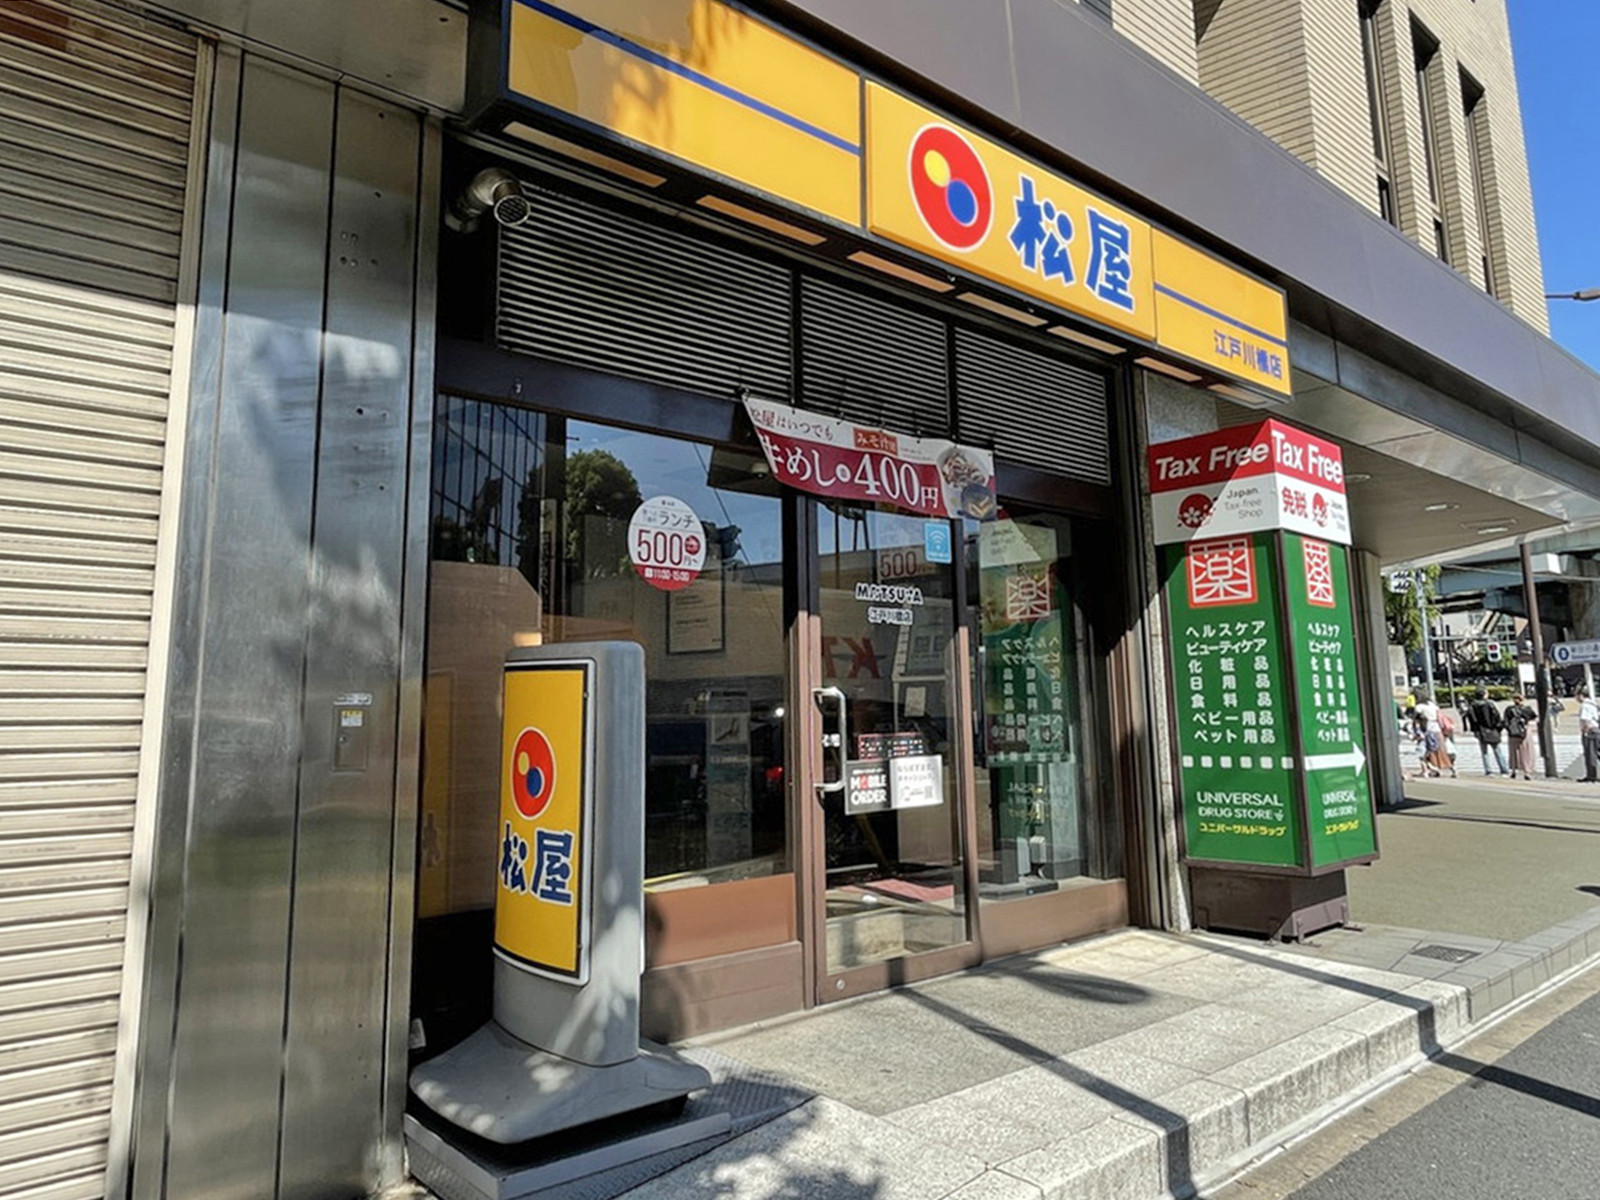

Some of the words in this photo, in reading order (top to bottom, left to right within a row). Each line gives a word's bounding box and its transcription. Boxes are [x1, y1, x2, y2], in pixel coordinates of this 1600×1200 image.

[1007, 173, 1136, 314] 松屋
[1156, 456, 1202, 480] Tax
[1209, 442, 1270, 472] Free
[1271, 430, 1303, 472] Tax
[1308, 444, 1343, 484] Free
[1226, 487, 1259, 499] Japan
[1281, 486, 1308, 519] 免税
[659, 510, 694, 528] ランチ
[637, 529, 683, 566] 500
[880, 550, 918, 578] 500
[1186, 620, 1266, 638] ヘルスケア
[1186, 638, 1268, 656] ビューティケア
[1188, 655, 1269, 674] 化粧品
[1190, 673, 1271, 691] 日用品
[1191, 691, 1272, 709] 食料品
[1192, 710, 1275, 726] ベビー用品
[850, 789, 887, 806] ORDER
[1196, 791, 1284, 808] UNIVERSAL
[1198, 806, 1233, 819] DRUG
[1234, 808, 1273, 820] STORE
[1199, 821, 1287, 837] ユニバーサルドラッグ
[499, 820, 575, 906] 松屋
